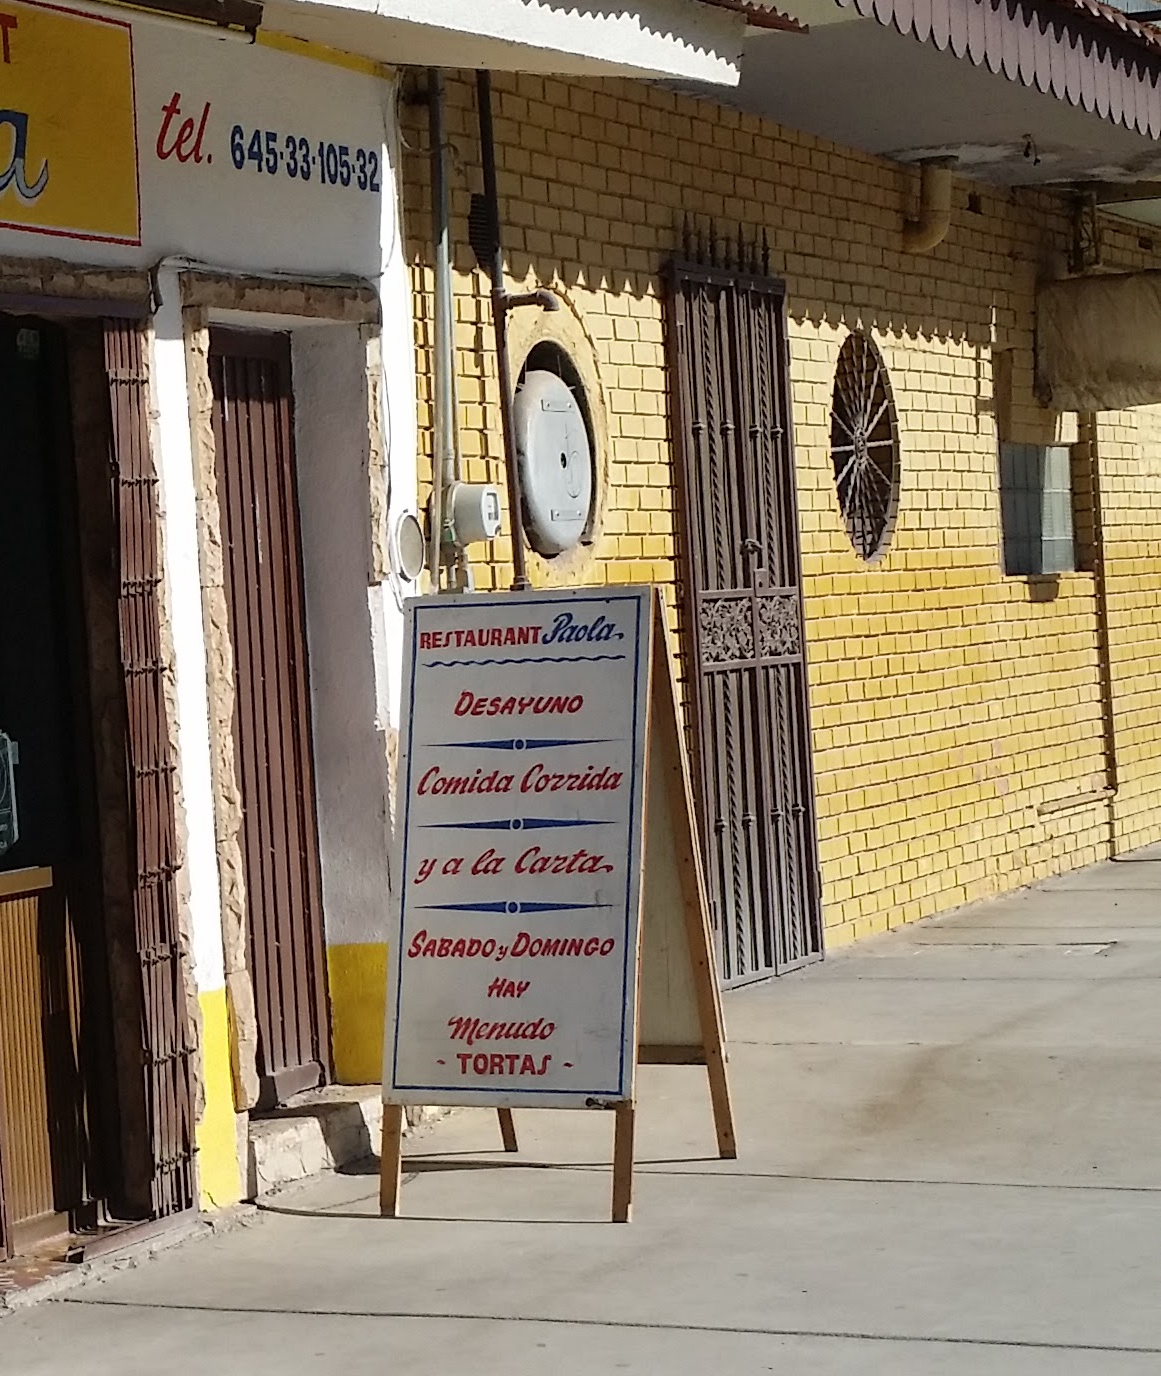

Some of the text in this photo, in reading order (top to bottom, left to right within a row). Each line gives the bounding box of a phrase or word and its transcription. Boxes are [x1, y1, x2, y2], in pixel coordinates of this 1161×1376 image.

[156, 92, 212, 164] tel.
[420, 612, 624, 650] RESTAURANT Paola
[454, 690, 584, 717] DESAYUNO
[417, 763, 623, 796] Comida Corrida
[414, 846, 614, 884] y a la Carta
[407, 929, 496, 959] SABADO
[510, 932, 615, 957] DOMINGO
[488, 977, 531, 998] HAY
[447, 1016, 556, 1046] Menudo
[456, 1053, 553, 1075] TORTAS
